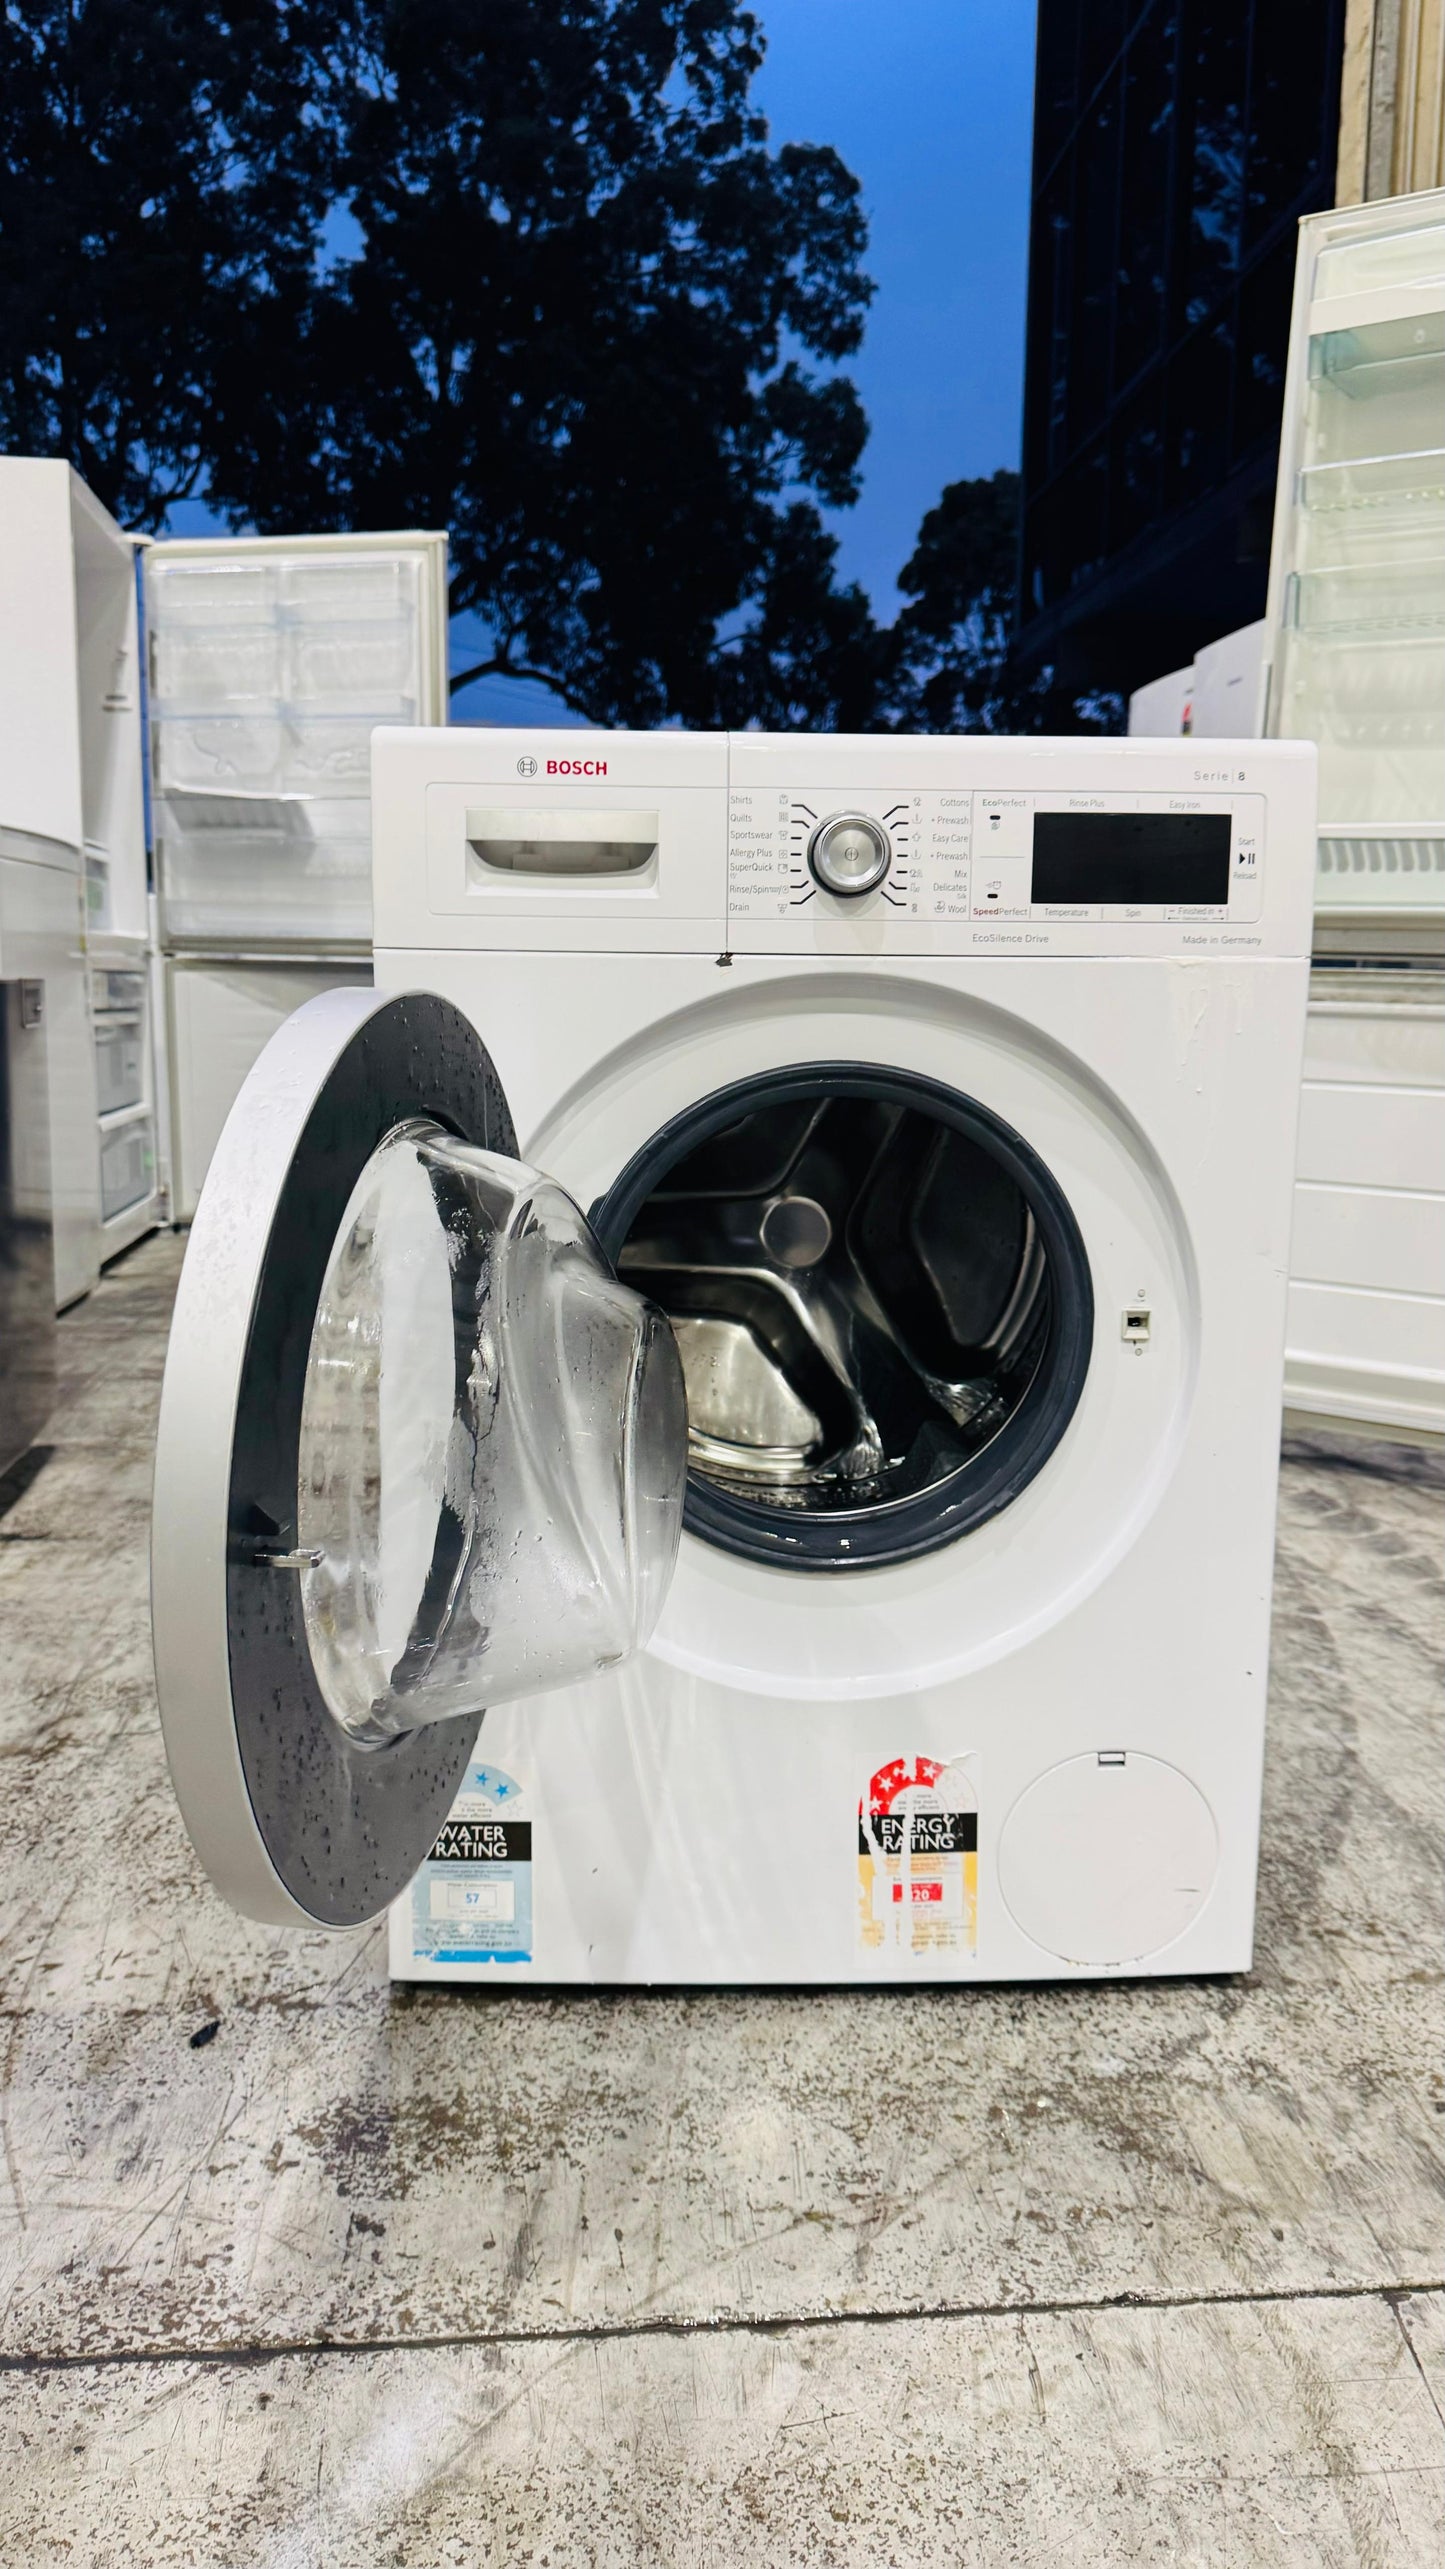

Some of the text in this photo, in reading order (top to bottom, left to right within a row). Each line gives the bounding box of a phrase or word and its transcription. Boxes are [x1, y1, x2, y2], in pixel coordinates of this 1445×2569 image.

[546, 760, 608, 776] BOSCH
[1194, 771, 1246, 781] Serie 8
[730, 795, 752, 805] Shirts
[940, 798, 969, 807] Cottons
[982, 798, 1026, 807] EcoPerfect
[730, 813, 752, 823] Quilts
[937, 815, 969, 825] Prewash
[730, 830, 773, 841] Sportswear
[932, 833, 968, 845] Easy Care
[730, 848, 772, 860] Allergy Plus
[936, 851, 968, 861] Prewash
[730, 862, 773, 873] SuperQuick
[954, 869, 967, 878] Mix
[730, 884, 770, 895] Rinse/Spin
[933, 882, 967, 892] Delicates
[729, 902, 750, 912] Drain
[948, 904, 967, 913] Wool
[973, 908, 1028, 918] SpeedPerfect
[1045, 908, 1089, 918] Temperature
[972, 933, 1049, 944] EcoSilence Drive
[1183, 935, 1262, 947] Made in Germany
[440, 1825, 506, 1841] WATER
[882, 1834, 955, 1851] RATING
[435, 1842, 508, 1858] RATING
[465, 1892, 480, 1904] 57
